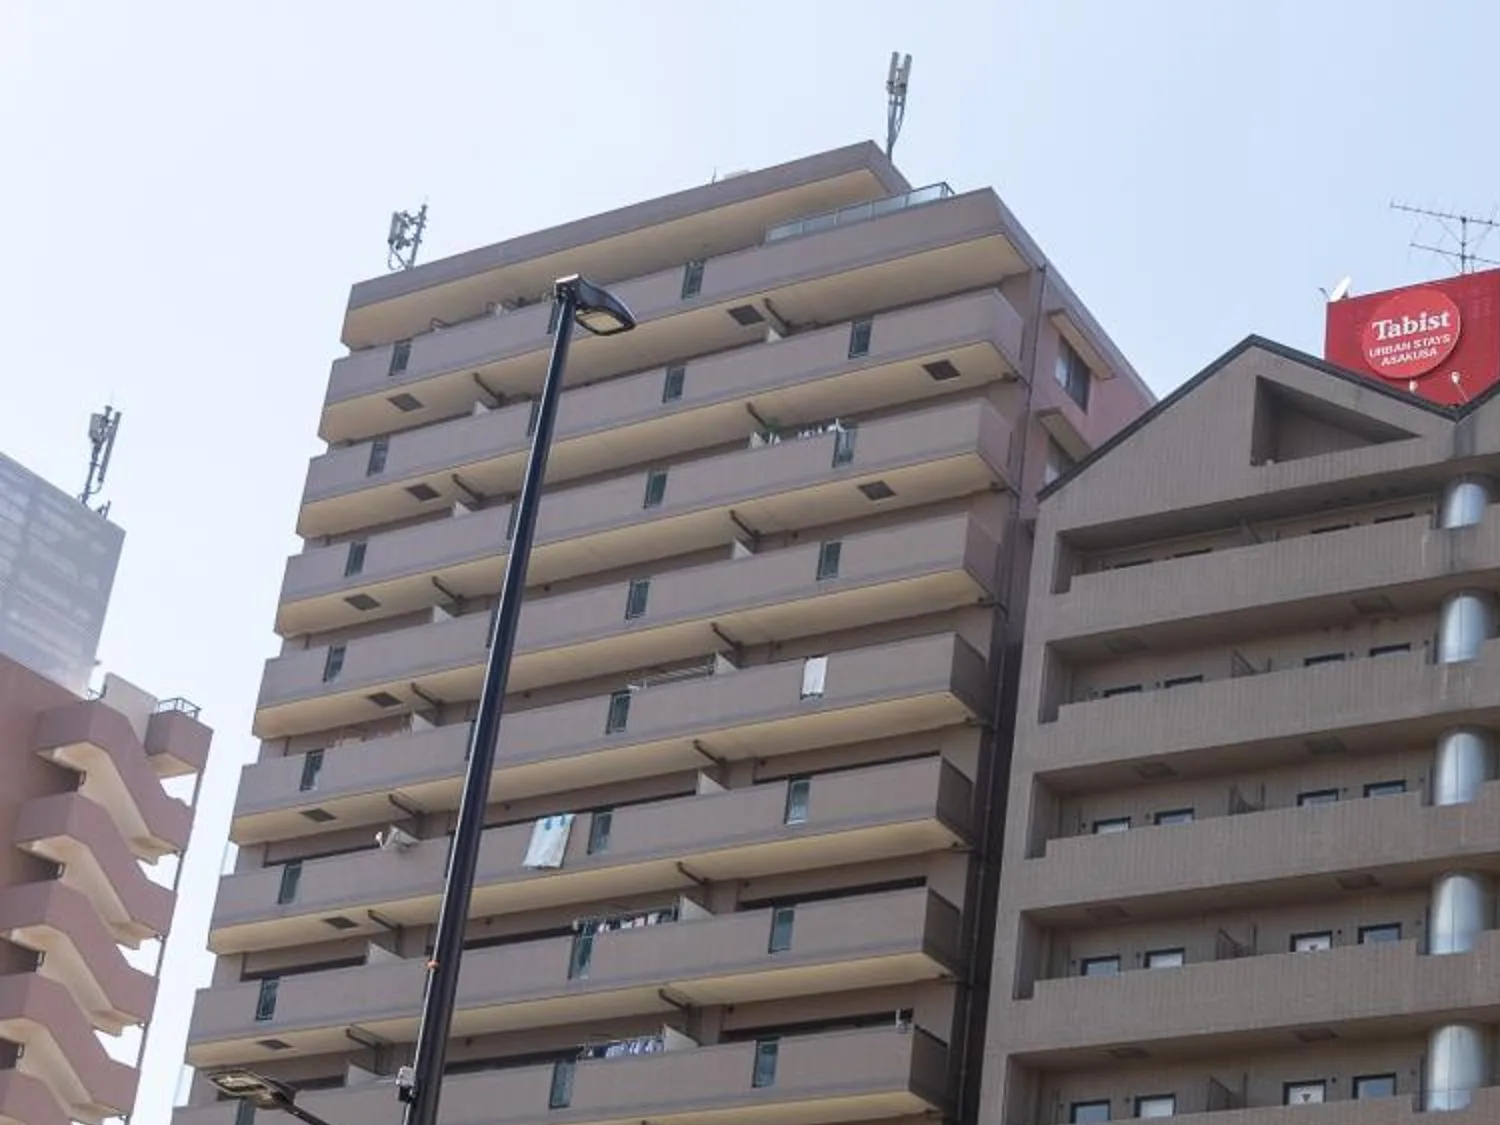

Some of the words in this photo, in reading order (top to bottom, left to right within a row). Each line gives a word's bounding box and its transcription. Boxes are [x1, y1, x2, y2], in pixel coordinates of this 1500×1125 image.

[1372, 310, 1451, 341] Tabist
[1369, 340, 1411, 358] URBAN
[1412, 333, 1451, 351] STAYS
[1381, 346, 1437, 366] ASAKUSA
